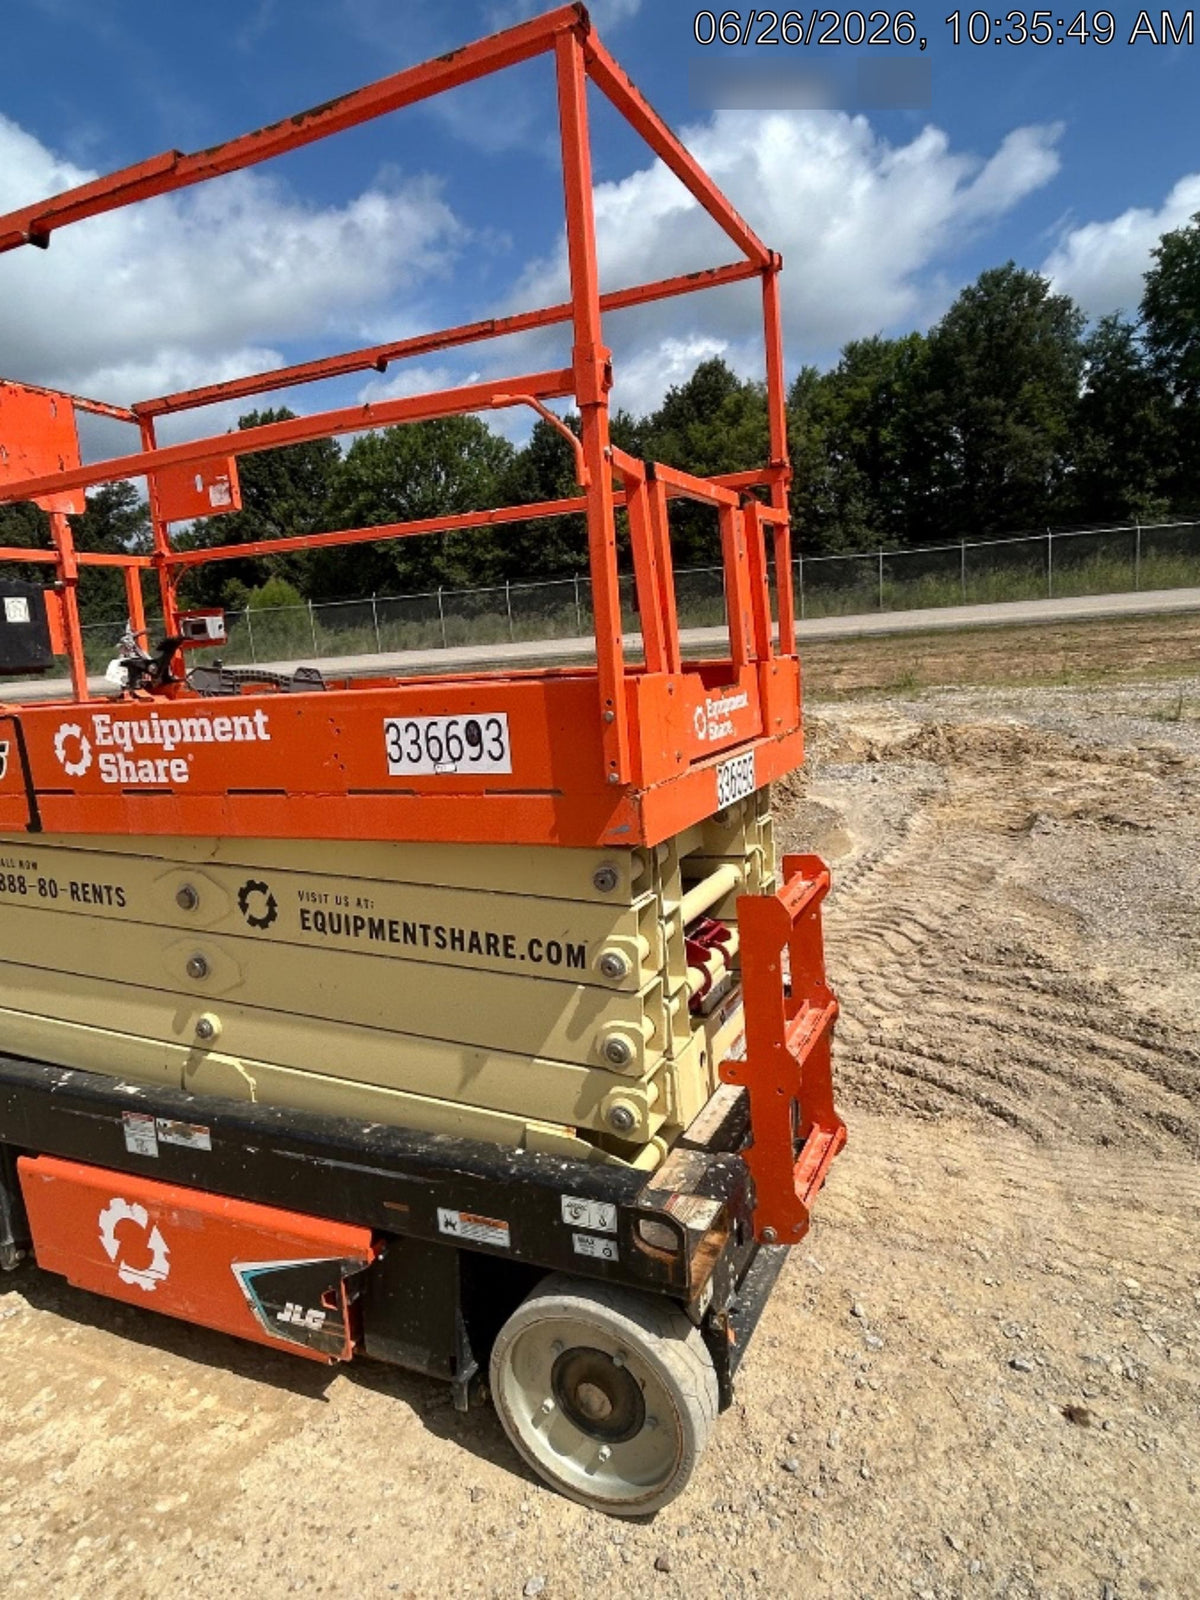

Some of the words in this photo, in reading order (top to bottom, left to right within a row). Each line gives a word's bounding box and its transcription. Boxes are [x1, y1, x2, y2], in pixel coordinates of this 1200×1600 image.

[706, 692, 749, 720] Equipment
[91, 708, 271, 752] Equipment
[385, 717, 505, 763] 336693
[298, 890, 329, 904] VISIT
[335, 895, 349, 907] US
[356, 897, 374, 909] AT:
[299, 908, 586, 969] EQUIPMENTSHARE.COM
[276, 1302, 326, 1330] JLG
